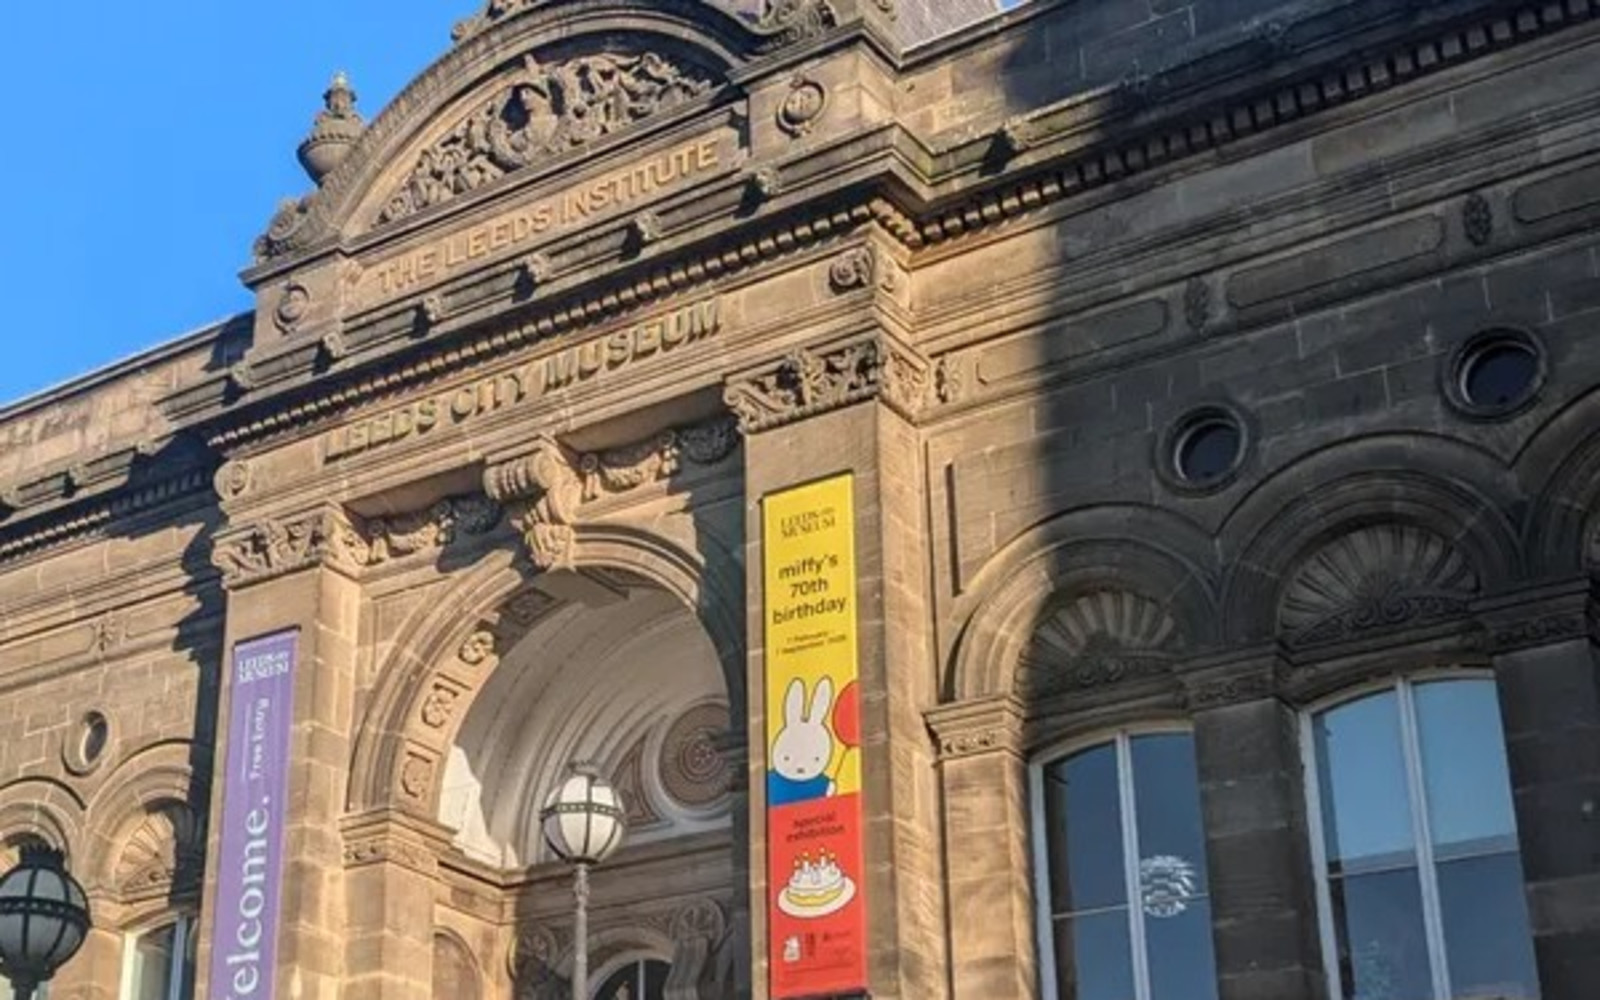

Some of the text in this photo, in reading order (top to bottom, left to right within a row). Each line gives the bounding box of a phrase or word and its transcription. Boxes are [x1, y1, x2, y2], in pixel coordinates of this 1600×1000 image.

[378, 140, 718, 294] THE LEEDS INSTITUTE
[322, 299, 721, 462] LEEDS CITY MUSEUM
[772, 597, 846, 624] birthday
[778, 554, 839, 579] miffy's
[790, 577, 828, 598] 70th
[226, 796, 270, 1000] elcome.
